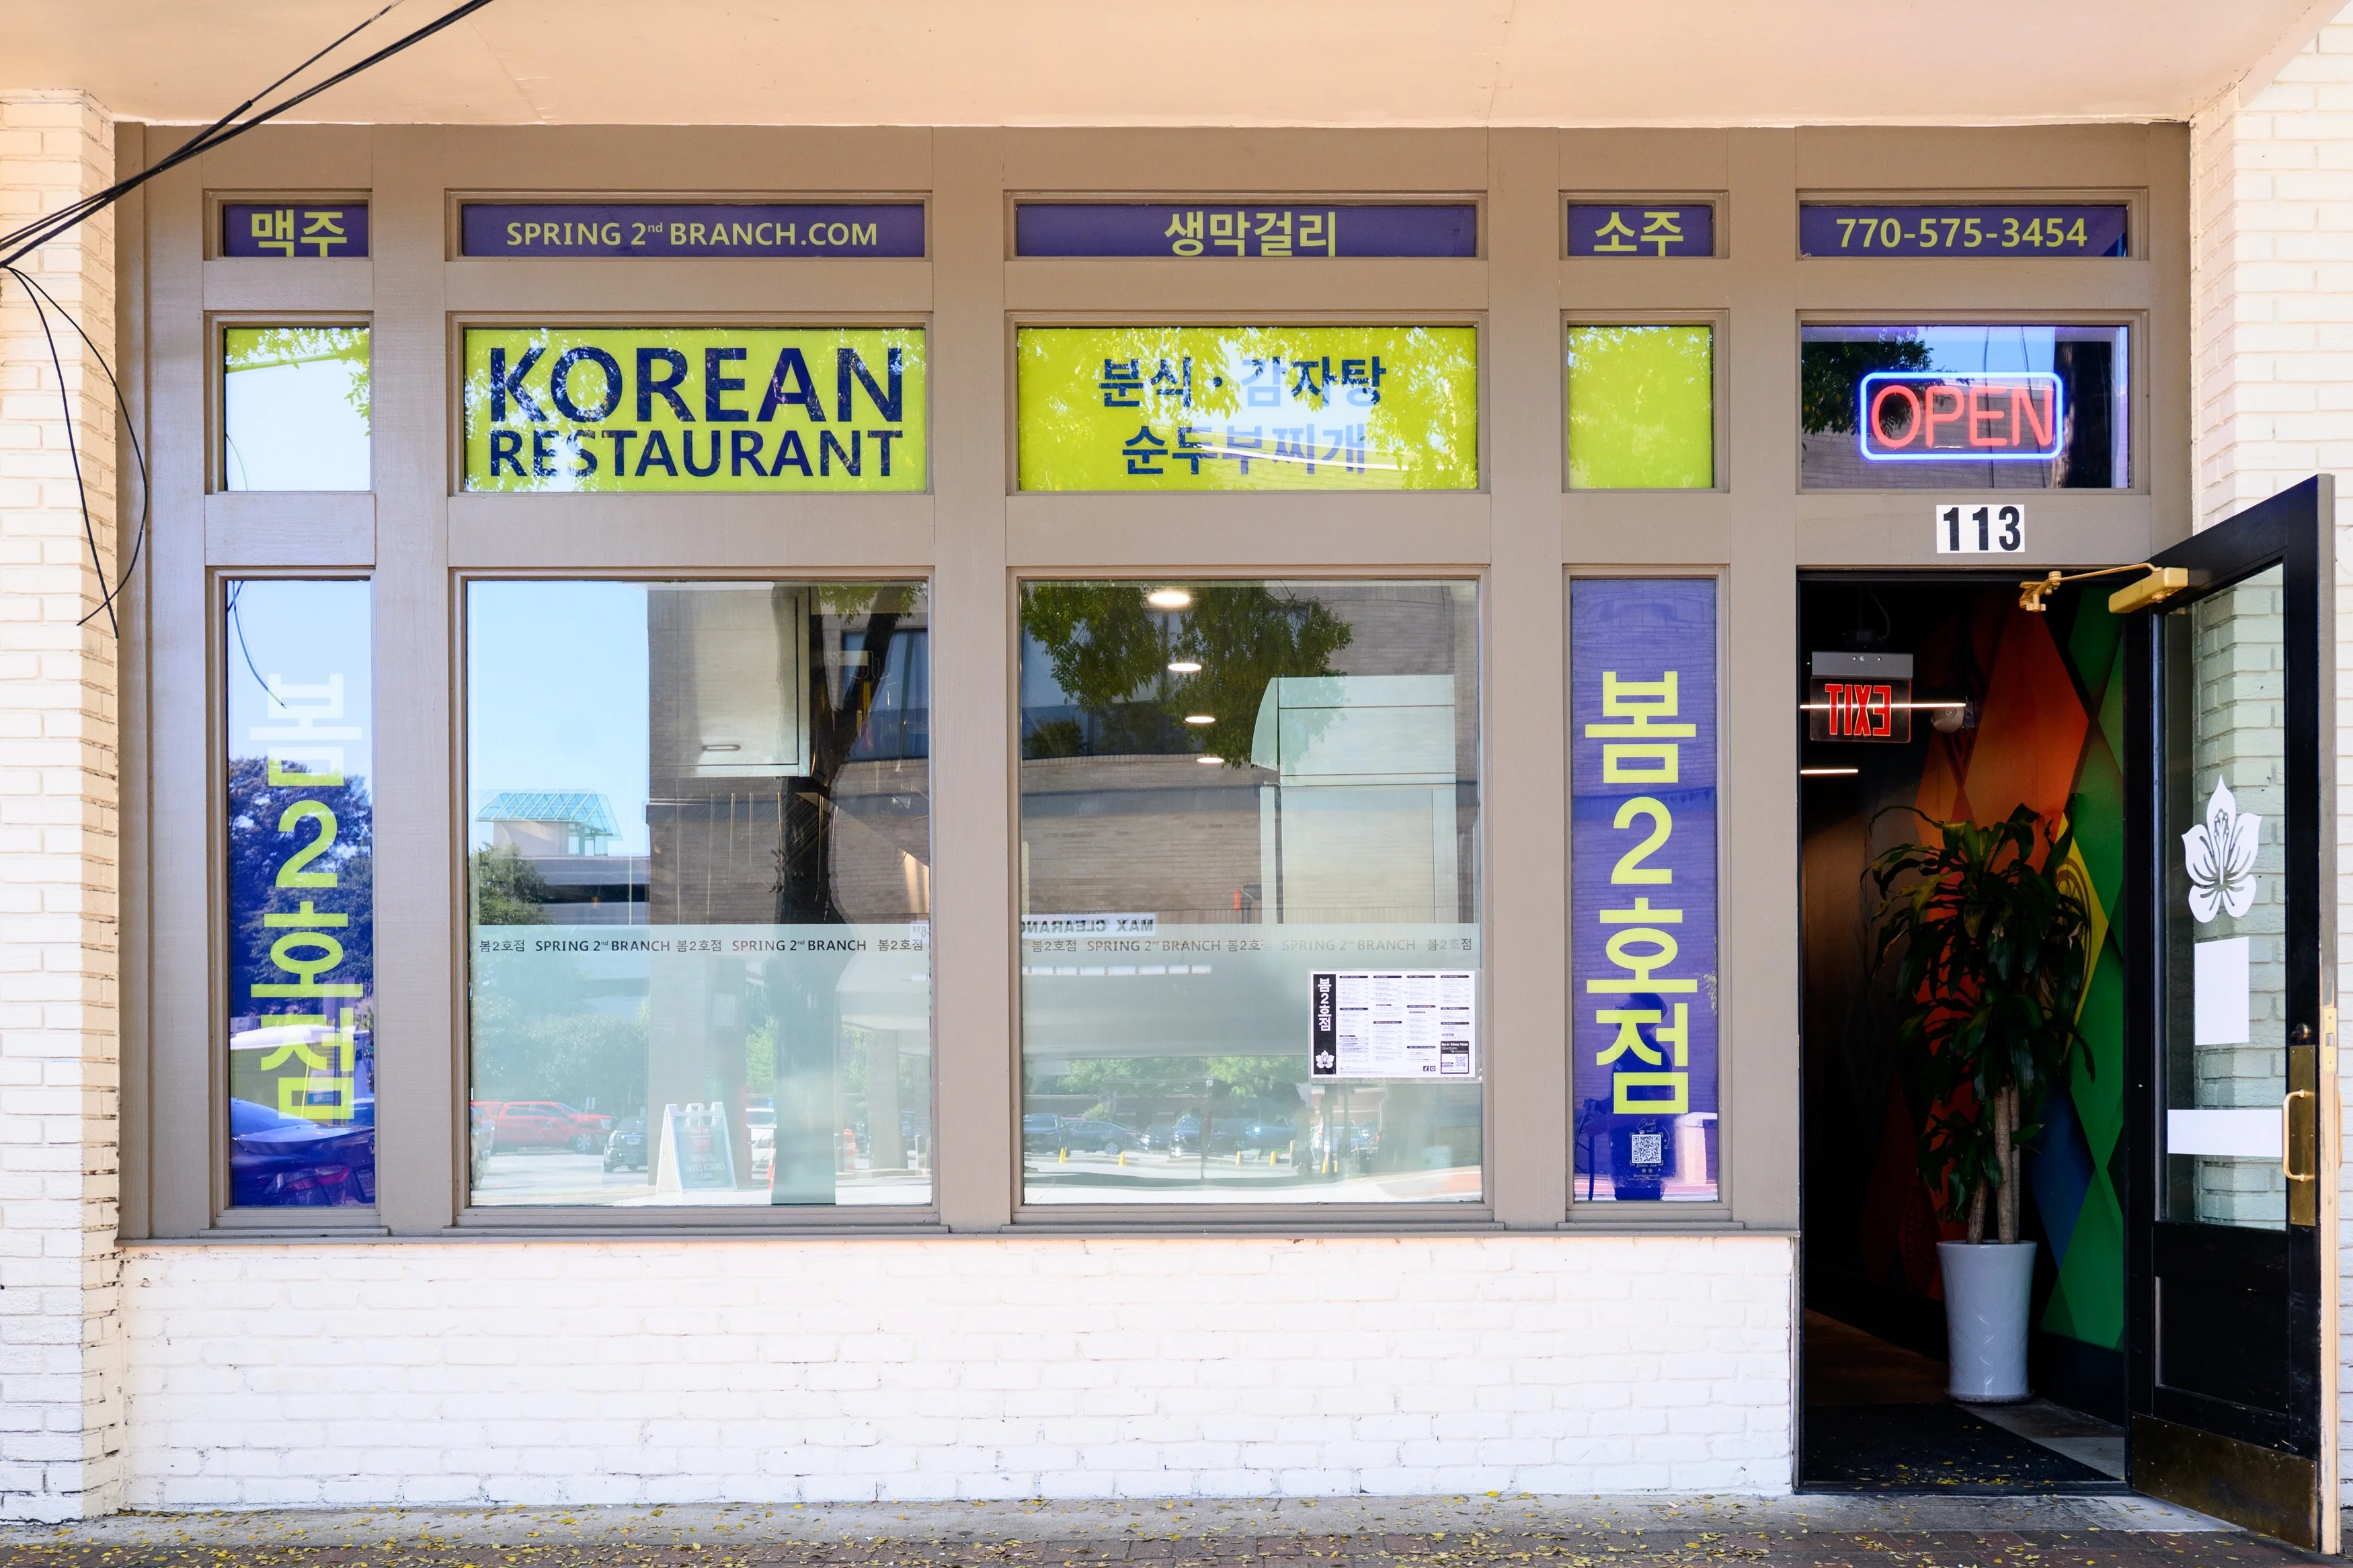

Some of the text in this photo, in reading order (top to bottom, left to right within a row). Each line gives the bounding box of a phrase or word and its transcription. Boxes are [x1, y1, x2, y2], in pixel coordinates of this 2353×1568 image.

[251, 209, 347, 257] 맥주
[507, 222, 877, 245] SPRING 2nd BRANCH.COM
[1165, 211, 1337, 257] 생막걸리
[1594, 212, 1684, 257] 소주
[1837, 218, 2087, 248] 770-575-3454
[490, 347, 903, 423] KOREAN
[1099, 357, 1191, 407] 분식
[1241, 356, 1386, 407] 감자탕
[1870, 384, 2054, 448] OPEN
[490, 429, 903, 477] RESTAURANT
[1123, 424, 1365, 475] 순두부찌개
[1943, 505, 2022, 552] 113
[250, 673, 364, 1120] 봄2호점
[1585, 671, 1698, 1114] 봄2호점
[479, 939, 923, 952] 봄2호점 SPRING 2nd BRANCH 봄2호점 SPRING 2nd BRANCH 봄2호점
[1031, 940, 1076, 952] 봄2호점
[1087, 940, 1140, 952] SPRING
[1144, 940, 1160, 952] 2nd
[1162, 940, 1221, 951] BRANCH
[1282, 940, 1335, 951] SPRING
[1357, 940, 1416, 950] BRANCH
[1427, 938, 1472, 951] 봄2호점
[1317, 977, 1332, 1032] 봄2호점
